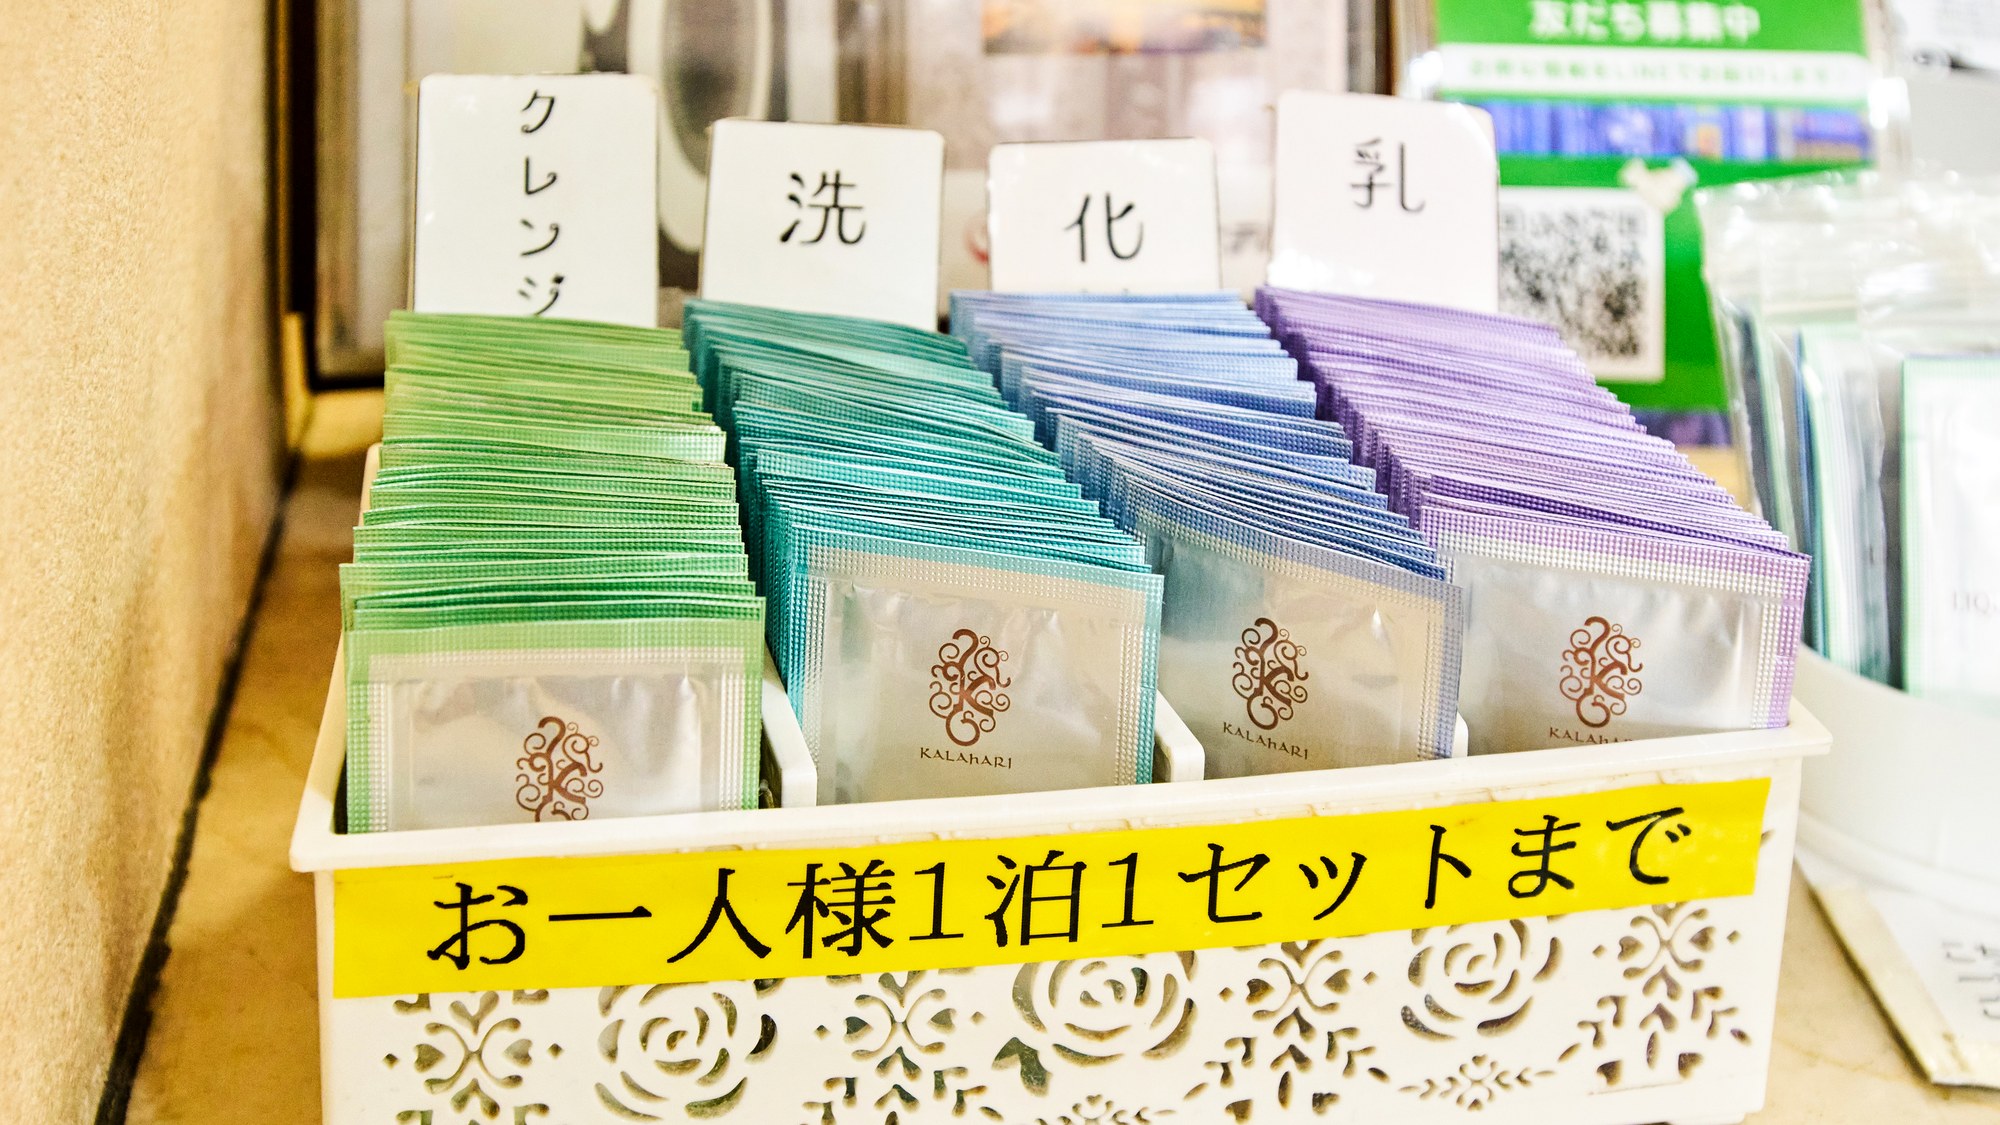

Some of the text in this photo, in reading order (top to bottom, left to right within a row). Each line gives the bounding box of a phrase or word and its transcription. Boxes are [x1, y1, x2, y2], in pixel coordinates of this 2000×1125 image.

[519, 89, 565, 316] クレンジ
[780, 170, 867, 246] 洗
[1350, 137, 1425, 214] 乳
[1064, 191, 1143, 263] 化
[427, 806, 1693, 971] お一人様1泊1セットまで
